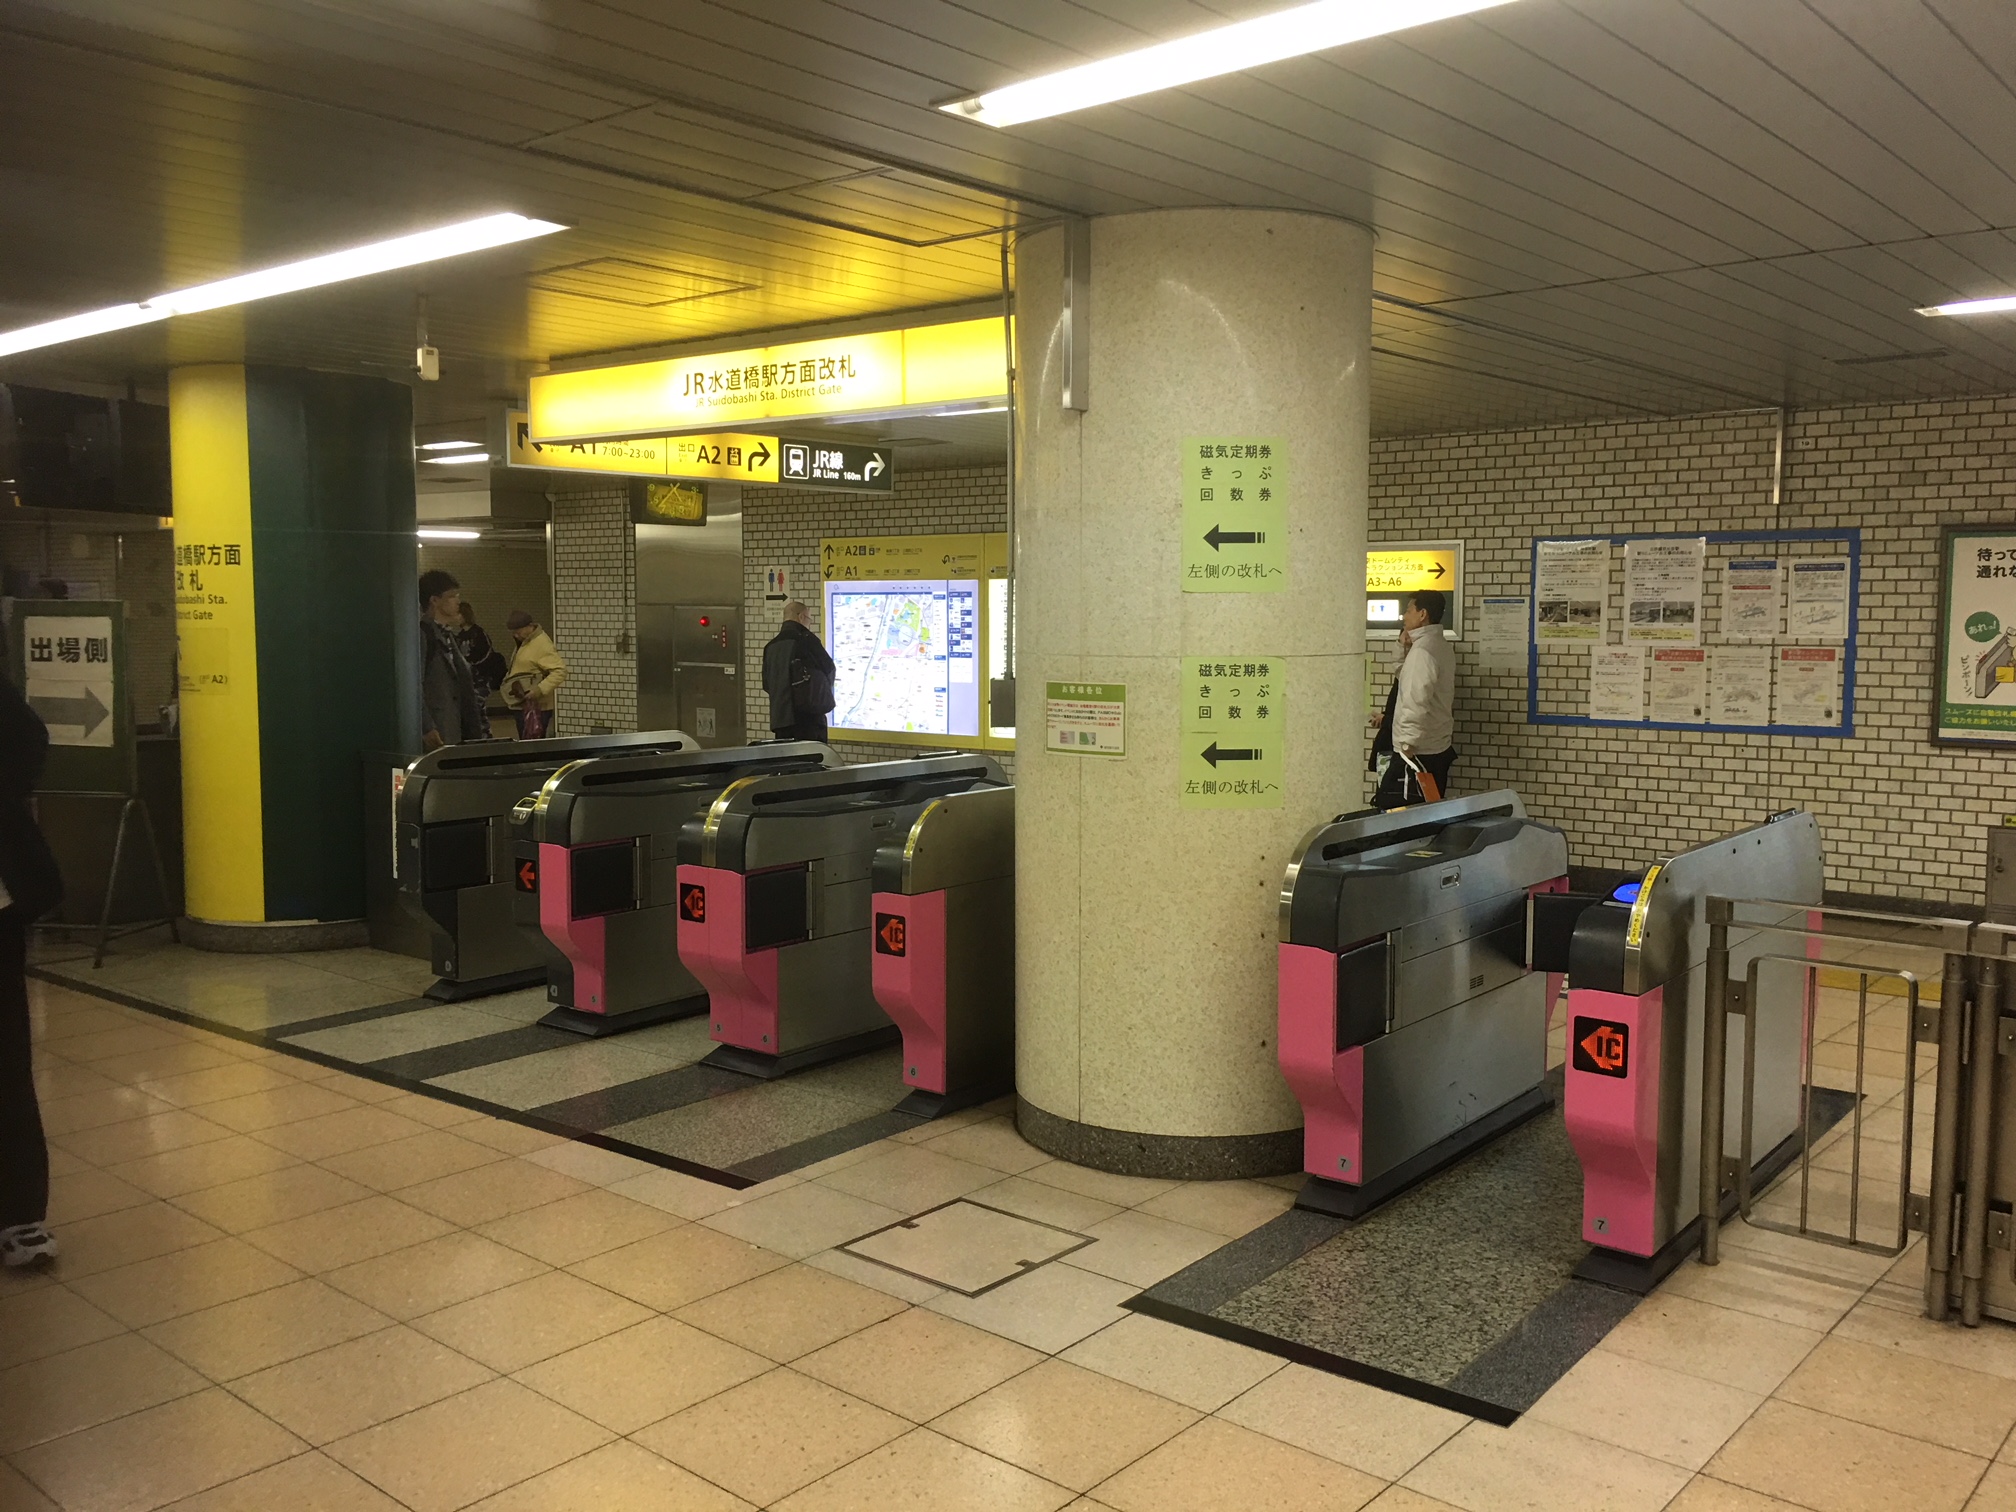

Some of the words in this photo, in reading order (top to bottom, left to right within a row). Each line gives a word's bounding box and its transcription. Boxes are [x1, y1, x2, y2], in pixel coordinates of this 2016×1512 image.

[683, 355, 856, 397] JR水道橋駅方面改札
[708, 392, 757, 407] Suidobashi
[760, 391, 778, 402] Sta.
[781, 386, 815, 399] District
[818, 383, 842, 395] Gate
[697, 445, 721, 465] A2
[1199, 444, 1272, 459] 磁気定期券
[812, 450, 843, 469] JR線
[812, 469, 822, 479] JR
[823, 470, 839, 480] Line
[843, 472, 862, 482] 160m
[1201, 466, 1272, 480] きっぷ
[1200, 487, 1272, 502] 回数券
[844, 545, 858, 557] A2
[844, 565, 858, 577] A1
[1187, 563, 1282, 579] 左側の改札へ
[207, 594, 228, 604] Sta.
[192, 609, 213, 620] Gate
[30, 637, 109, 663] 出場側
[1198, 663, 1270, 678] 磁気定期券
[1199, 684, 1270, 698] きっぷ
[1198, 705, 1270, 719] 回数券
[1184, 779, 1279, 796] 左側の改札へ
[1597, 1036, 1621, 1060] IC
